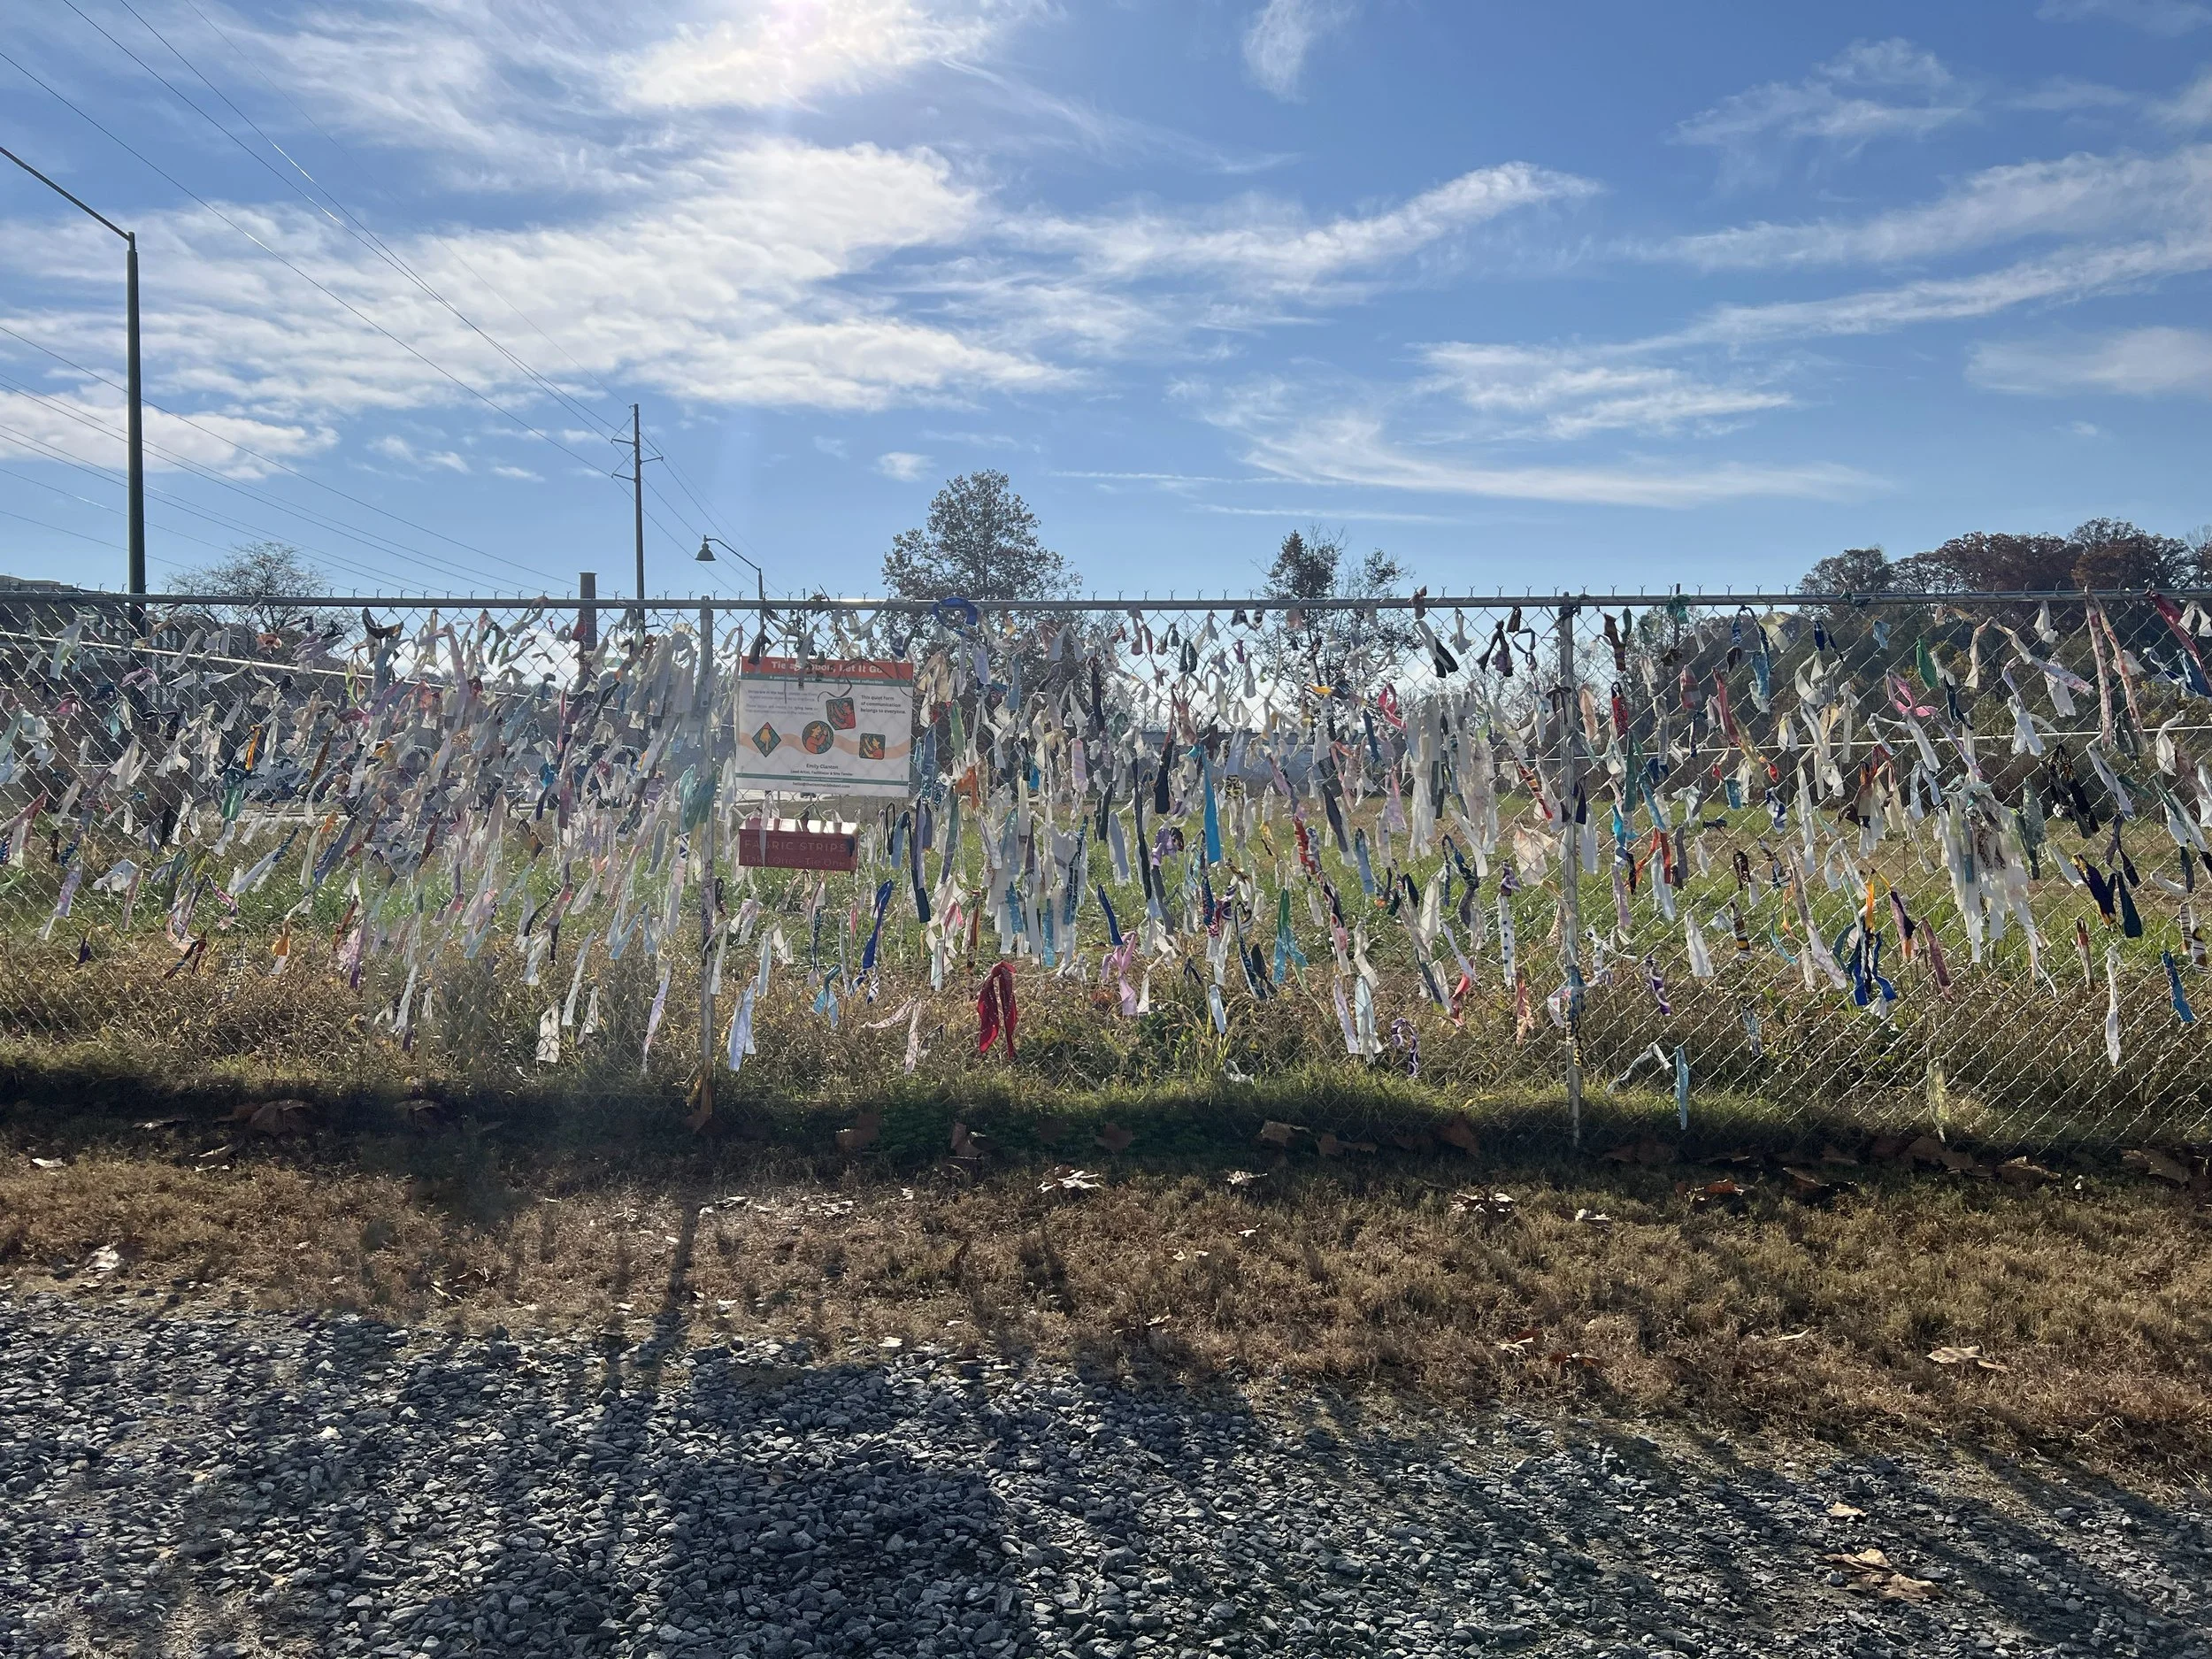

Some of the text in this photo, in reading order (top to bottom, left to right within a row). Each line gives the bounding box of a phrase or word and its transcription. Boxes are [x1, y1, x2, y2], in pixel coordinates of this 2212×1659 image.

[772, 661, 786, 670] Tie
[869, 664, 882, 673] Go
[800, 841, 846, 853] STRIPS
